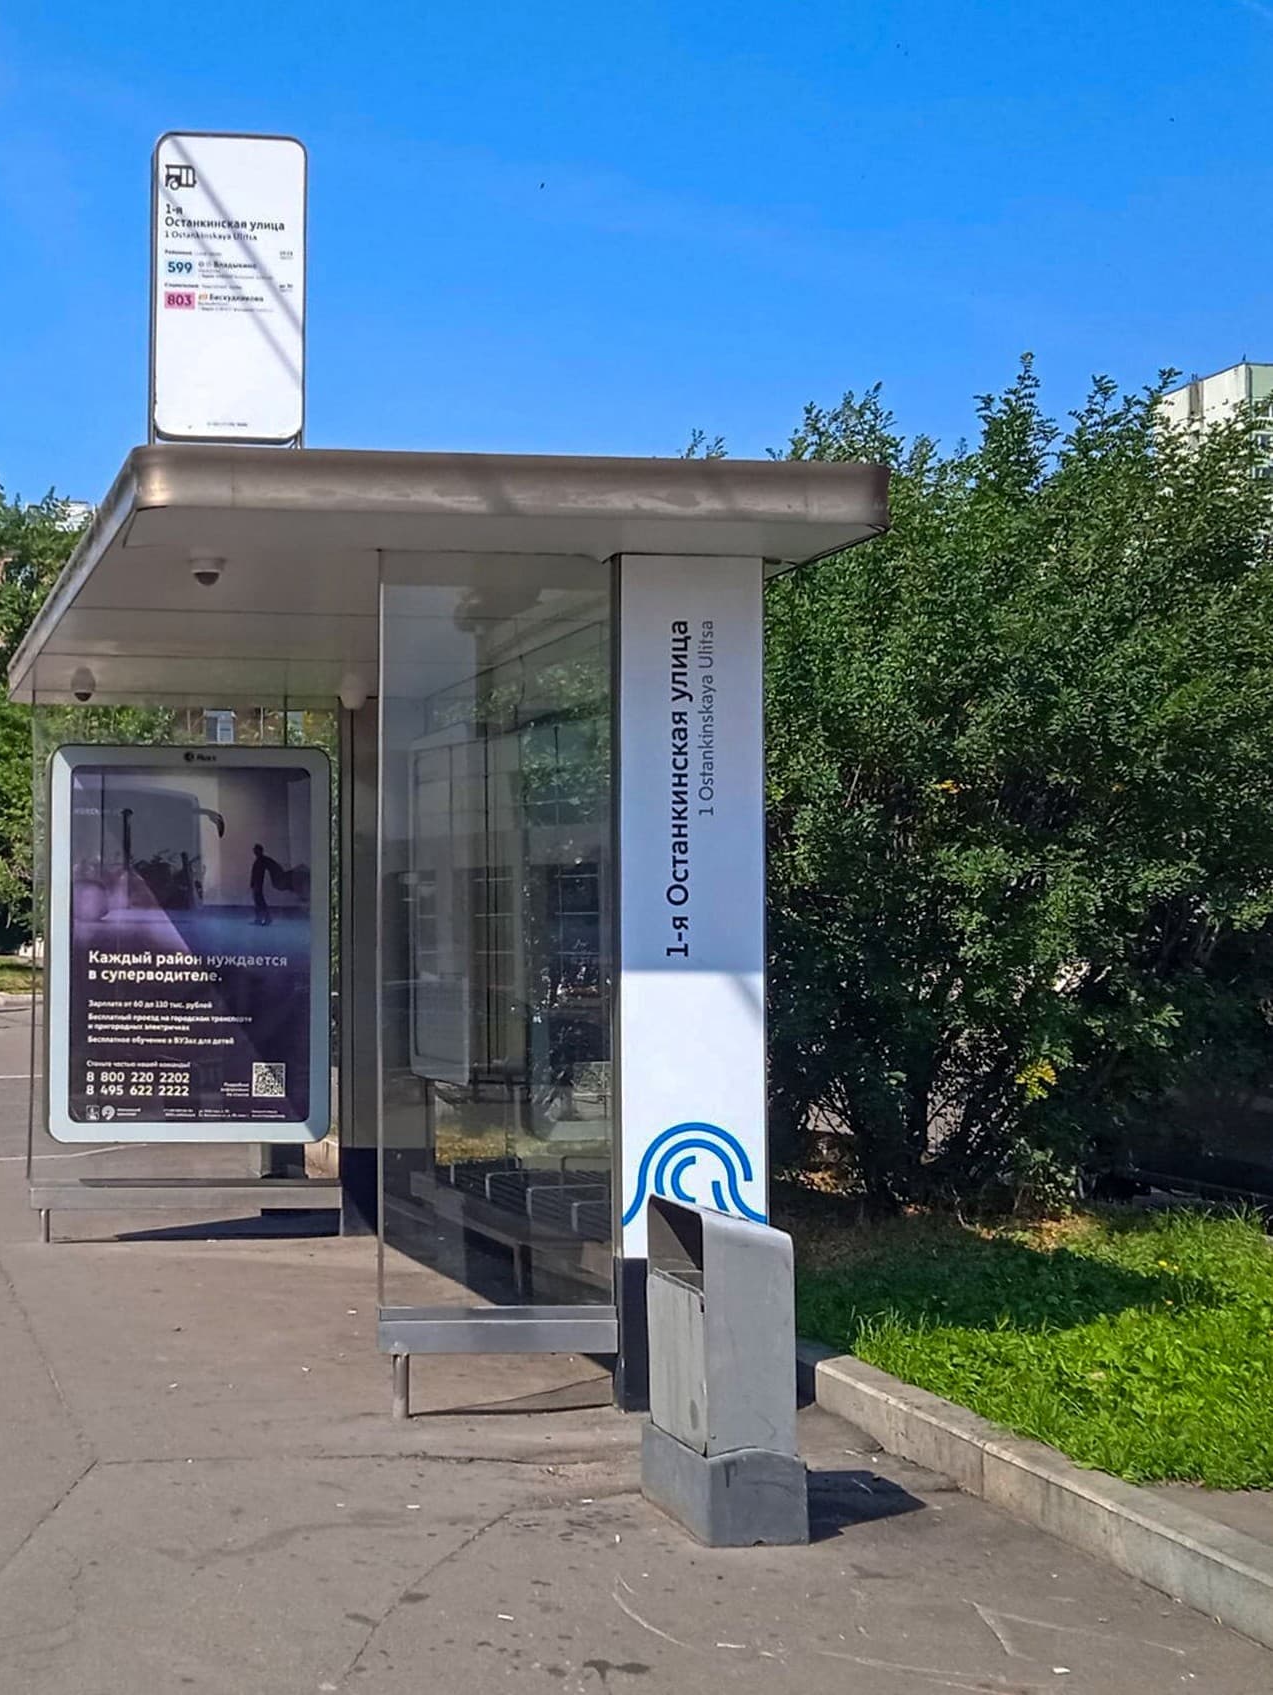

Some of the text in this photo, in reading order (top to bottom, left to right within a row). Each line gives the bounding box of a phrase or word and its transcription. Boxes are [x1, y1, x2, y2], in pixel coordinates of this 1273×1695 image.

[165, 204, 183, 215] 1-я
[165, 216, 285, 232] Останкинская улица
[167, 261, 193, 273] 599
[167, 294, 192, 306] 803
[699, 620, 717, 816] 1 Ostankinskaya Ulitsa
[666, 620, 693, 957] 1-я Останкинская улица
[88, 950, 287, 968] Каждый район нуждается
[88, 970, 223, 983] в суперводителе.
[88, 1000, 123, 1009] Зарплата
[133, 1000, 143, 1008] 60
[88, 1012, 132, 1021] Бесплатный
[86, 1071, 190, 1083] 8 800 220 2202
[86, 1084, 190, 1096] 8 495 622 2222
